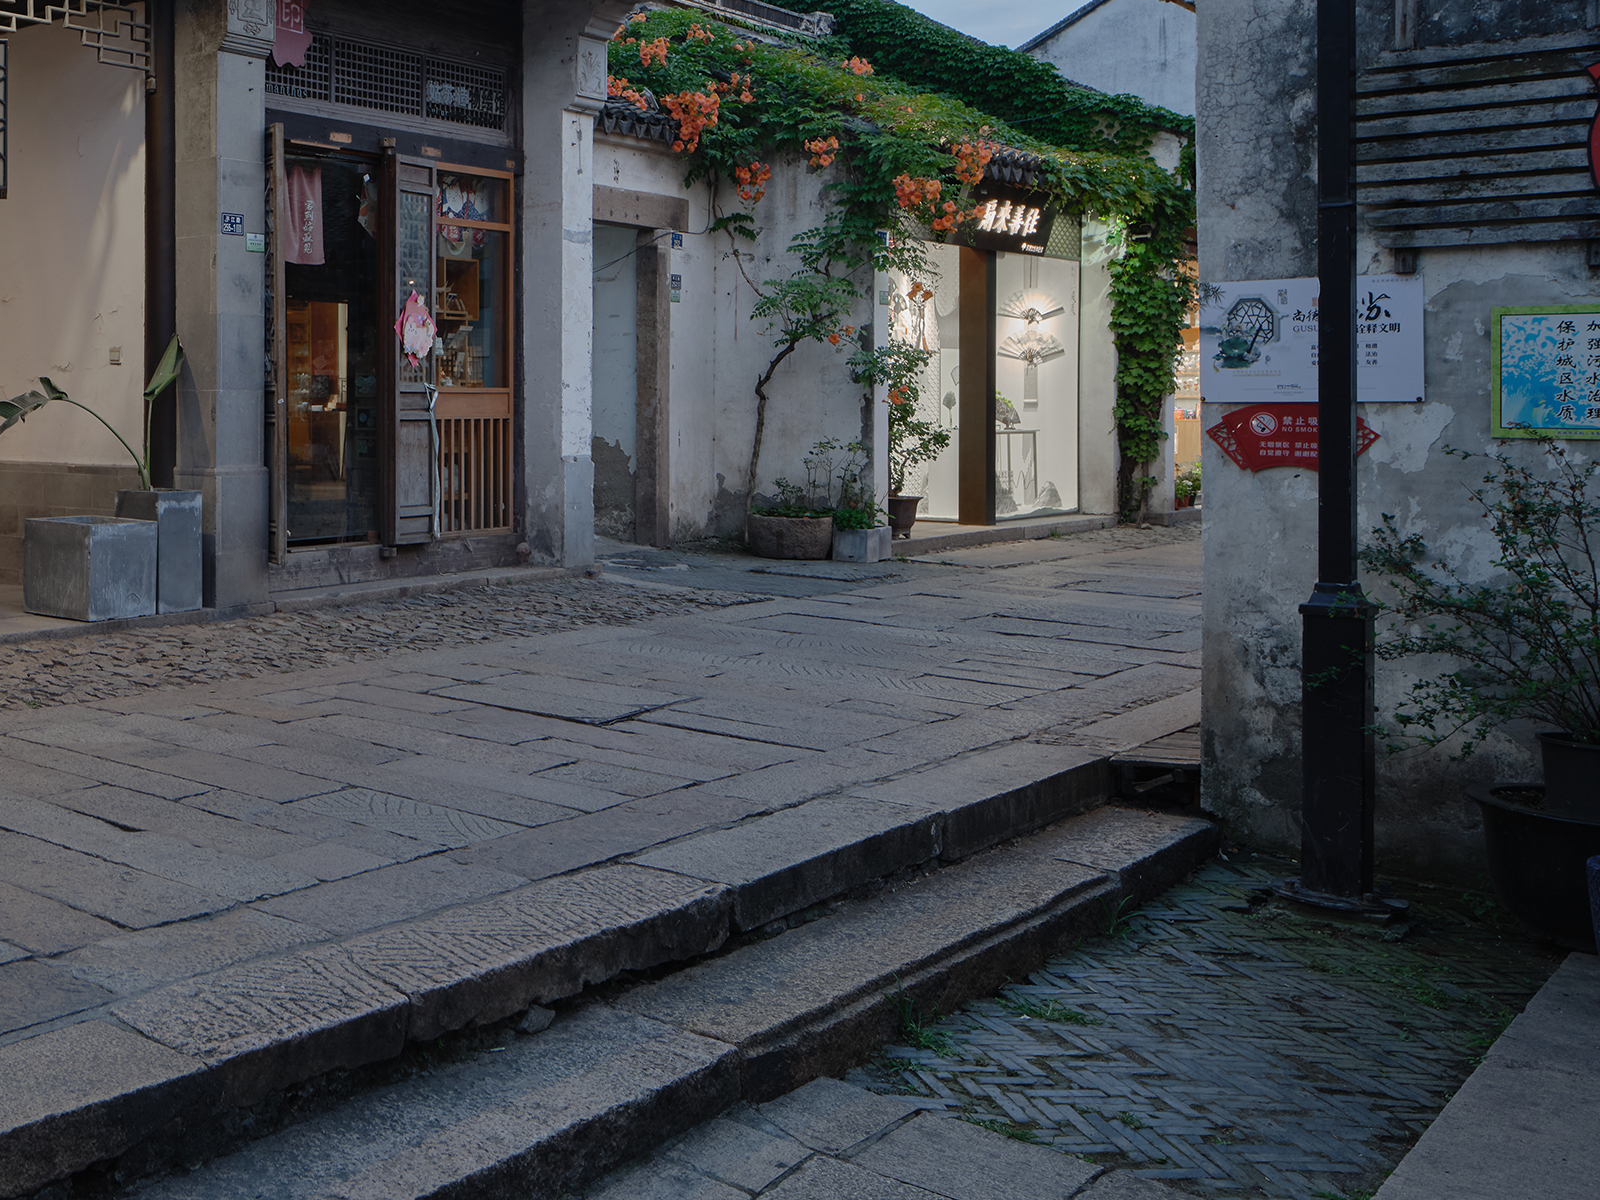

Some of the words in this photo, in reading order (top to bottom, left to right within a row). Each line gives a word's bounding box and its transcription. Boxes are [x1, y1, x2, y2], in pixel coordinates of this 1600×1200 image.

[1556, 320, 1577, 421] 保护城区水质
[1282, 416, 1318, 426] 禁止吸
